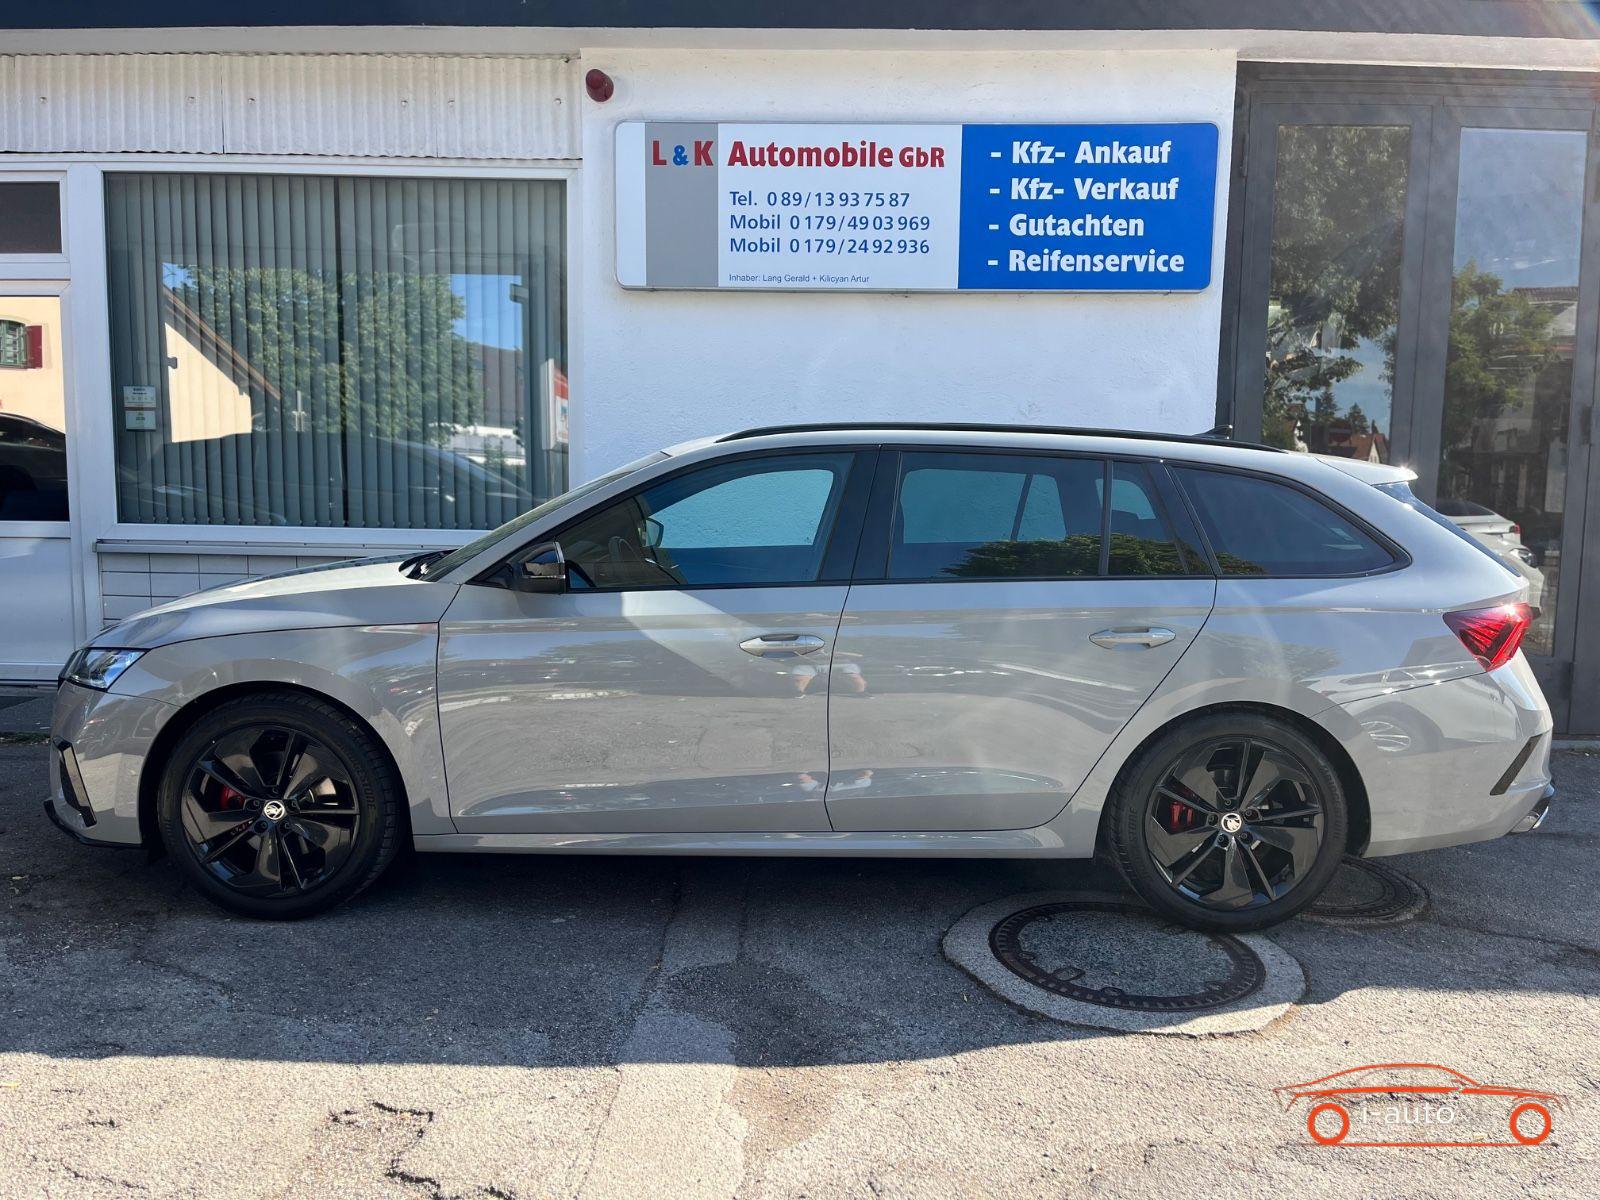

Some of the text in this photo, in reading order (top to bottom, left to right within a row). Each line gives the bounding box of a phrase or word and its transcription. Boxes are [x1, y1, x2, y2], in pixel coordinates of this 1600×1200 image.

[652, 140, 945, 168] L & K Automobile GbR
[1012, 140, 1066, 164] Kfz-
[1075, 141, 1171, 163] Ankauf
[729, 190, 758, 206] Tel.
[1011, 177, 1065, 200] Kfz-
[1074, 178, 1179, 200] Verkauf
[730, 214, 781, 230] Mobil
[1009, 214, 1144, 236] Gutachten
[730, 237, 781, 253] Mobil
[1009, 249, 1184, 272] Reifenservice
[729, 274, 761, 283] Inhaber:
[762, 274, 782, 284] Lang
[784, 274, 810, 283] Gerald
[850, 275, 870, 283] Artur
